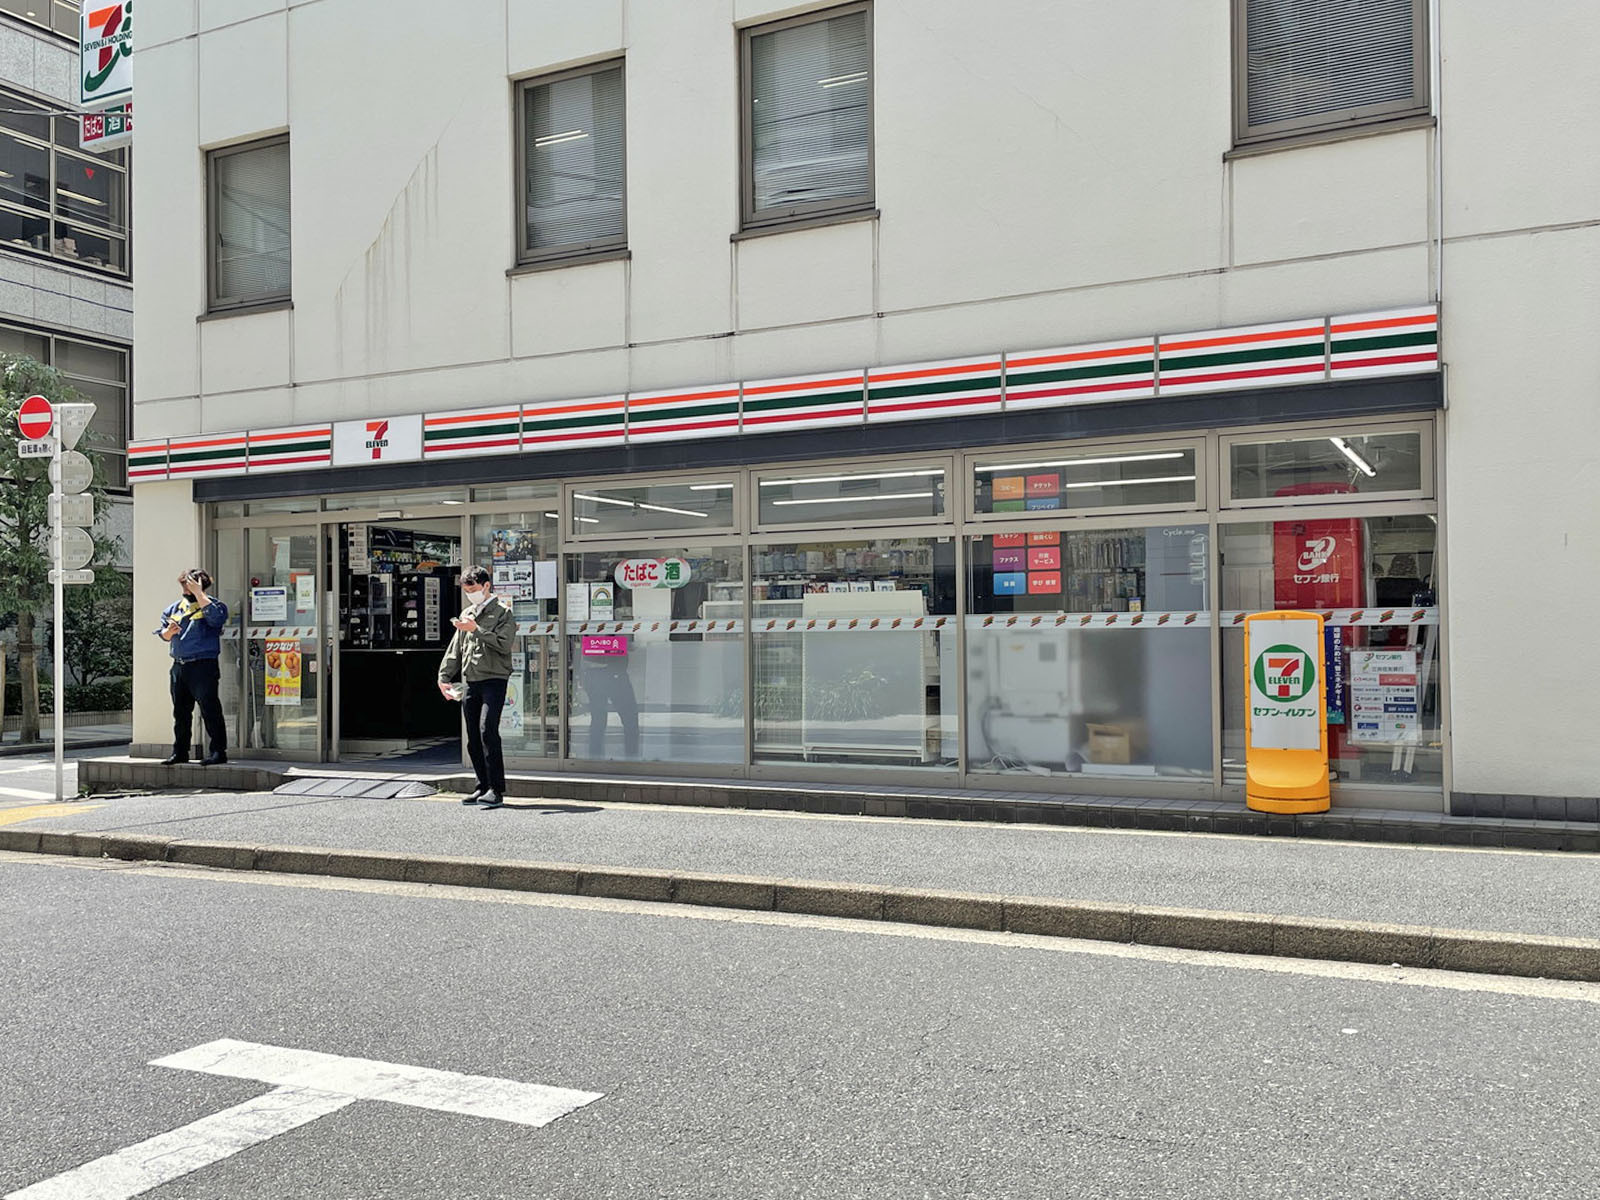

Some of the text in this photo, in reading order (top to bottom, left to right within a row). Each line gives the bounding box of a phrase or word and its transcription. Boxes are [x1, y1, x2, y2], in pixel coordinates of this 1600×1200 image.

[85, 115, 103, 137] たばこ
[366, 420, 388, 459] 7
[624, 562, 681, 581] たばこ 酒
[1293, 573, 1340, 584] セブン銀行
[1268, 658, 1299, 697] 7
[1253, 706, 1316, 718] セブン-イレブン
